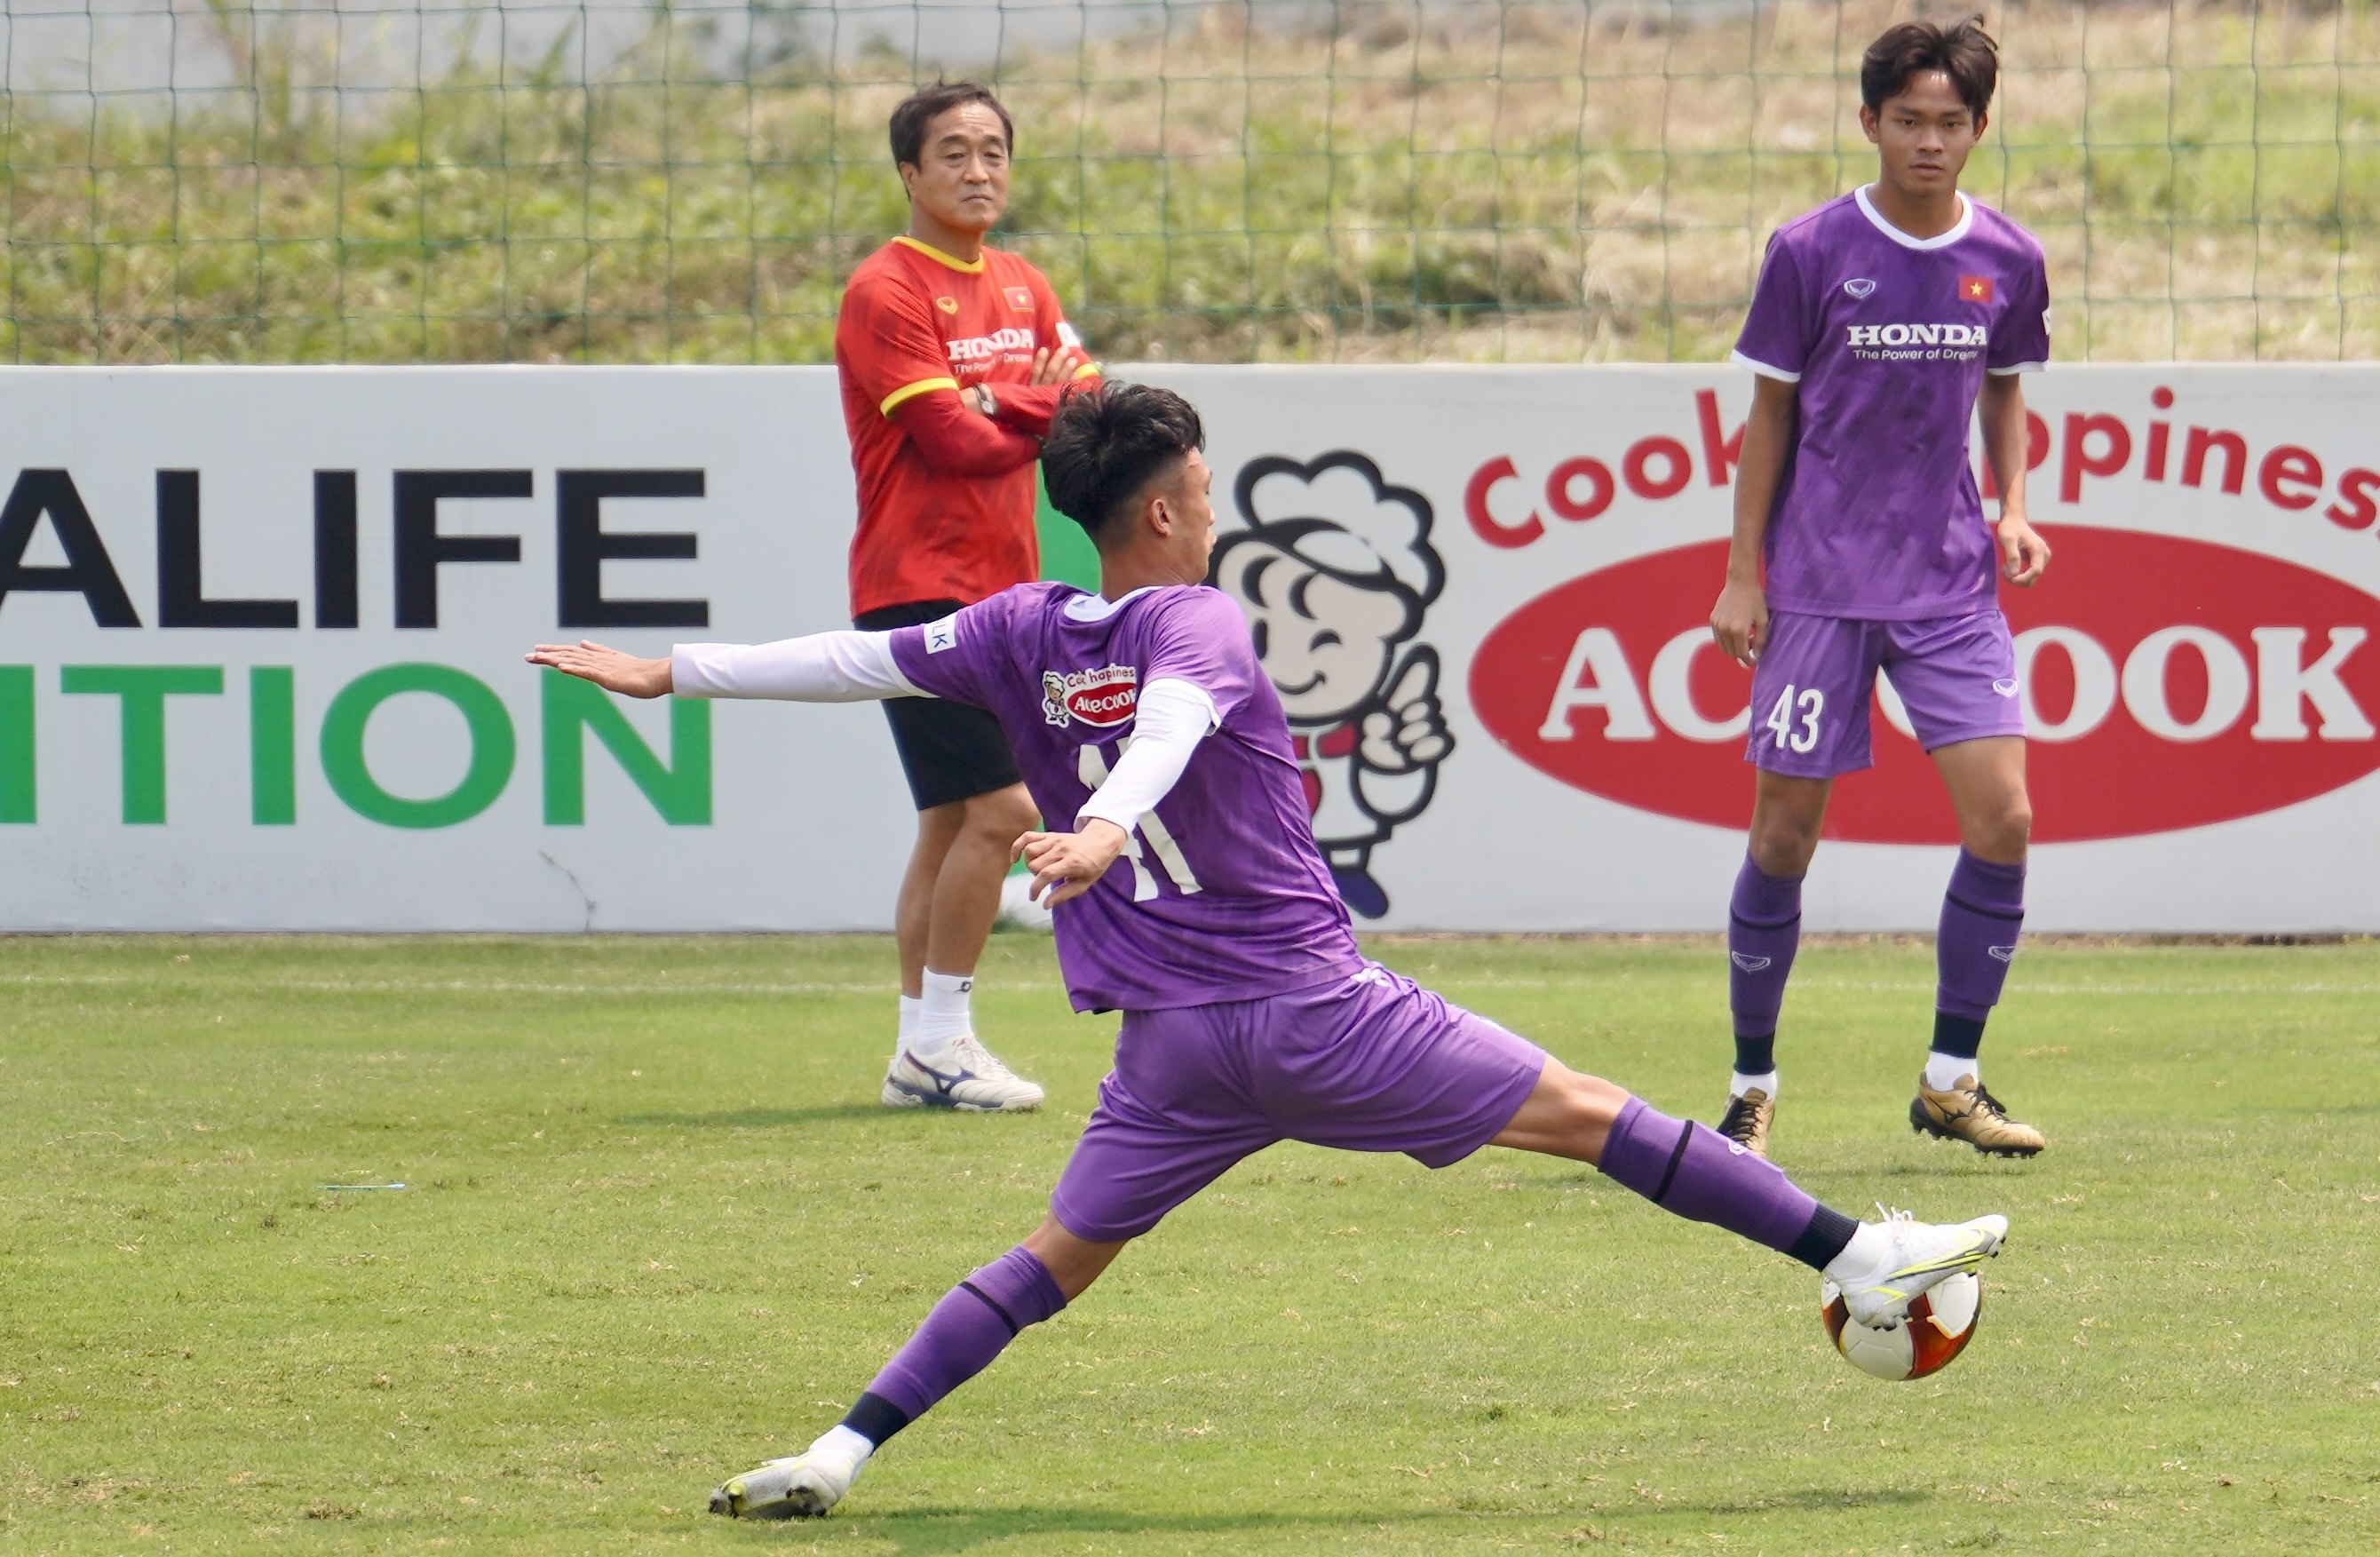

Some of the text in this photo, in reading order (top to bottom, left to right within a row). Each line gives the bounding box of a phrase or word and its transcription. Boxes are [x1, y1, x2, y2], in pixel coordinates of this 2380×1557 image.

[946, 328, 1034, 361] HONDA
[1846, 323, 1987, 346] HONDA
[1852, 349, 1879, 360] The
[1881, 349, 1924, 361] Power
[1925, 347, 1940, 361] of
[1463, 386, 1749, 551] Cook
[0, 468, 710, 629] ALIFE
[1536, 625, 2376, 743] ACOOK
[1766, 684, 1824, 754] 43
[0, 661, 712, 830] ITION
